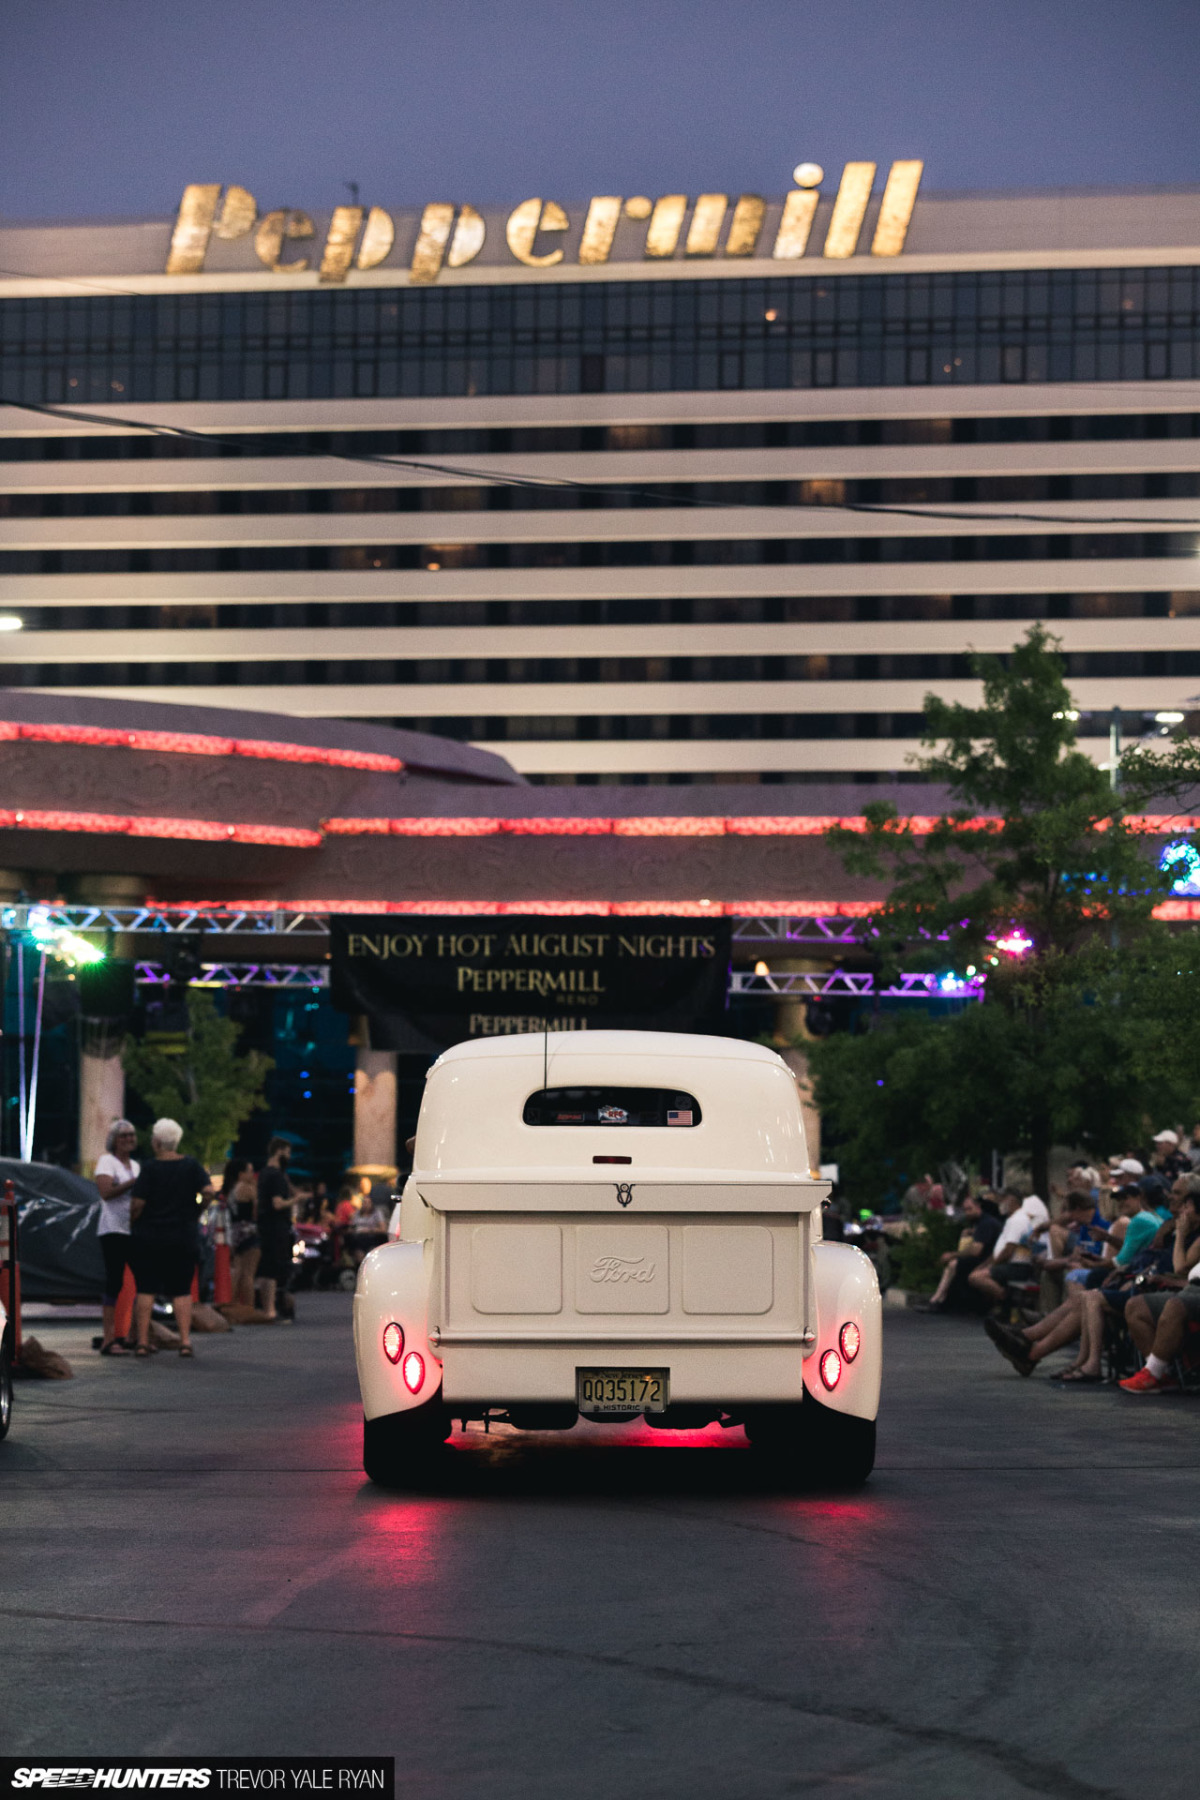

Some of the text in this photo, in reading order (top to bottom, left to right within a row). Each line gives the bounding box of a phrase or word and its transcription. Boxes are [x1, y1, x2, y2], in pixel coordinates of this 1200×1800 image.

[165, 160, 924, 285] Peppermill
[348, 934, 716, 960] ENJOY HOT AUGUST NIGHTS
[457, 967, 606, 996] PEPPERMILL
[590, 1255, 655, 1283] Ford
[583, 1380, 661, 1402] QQ35172
